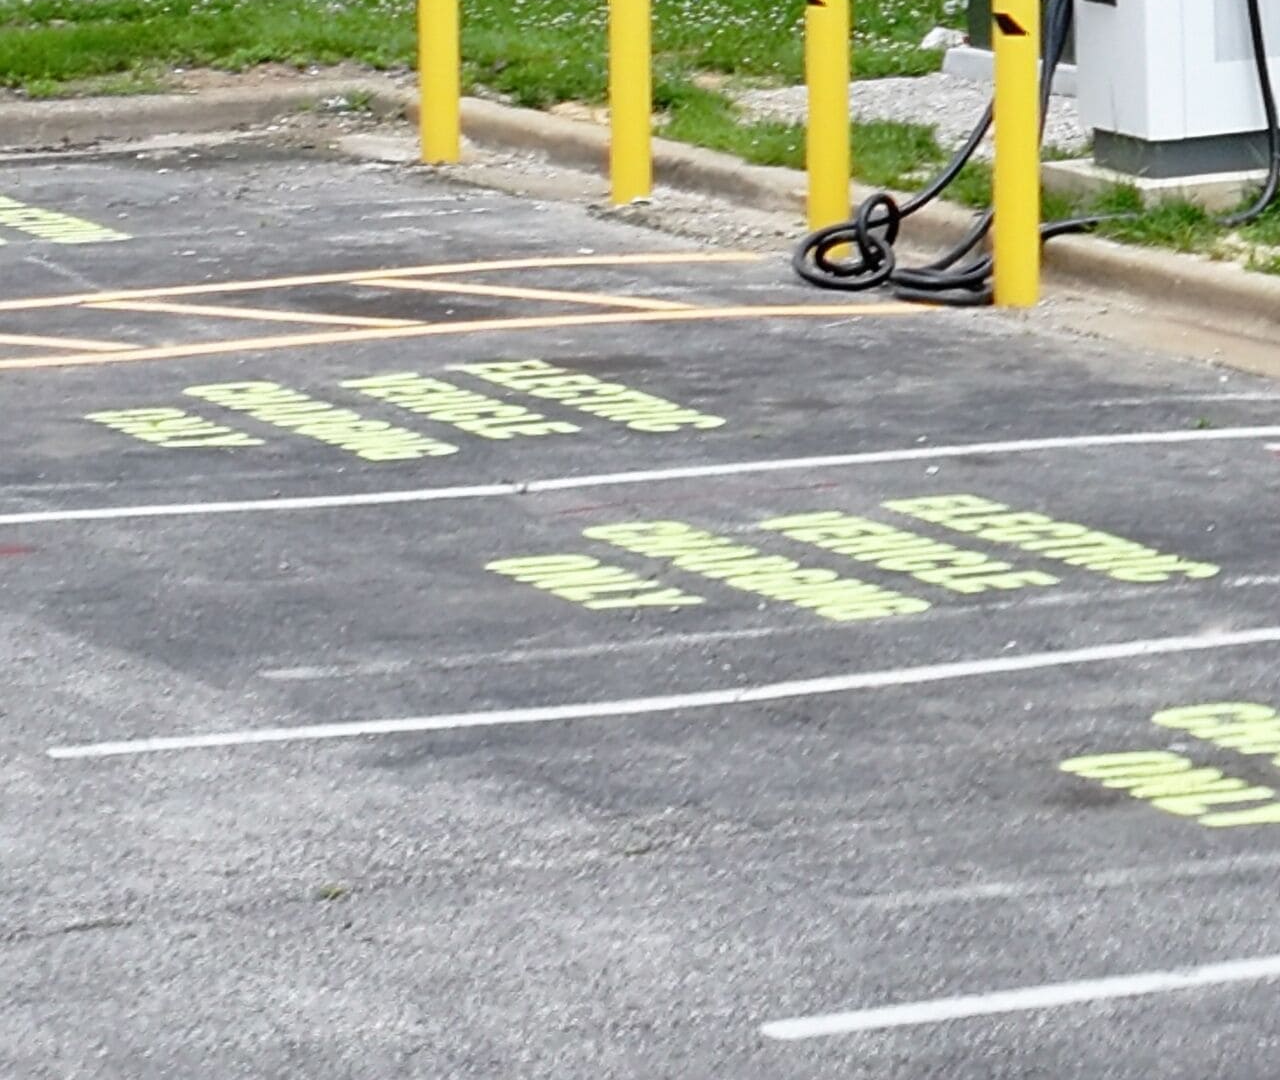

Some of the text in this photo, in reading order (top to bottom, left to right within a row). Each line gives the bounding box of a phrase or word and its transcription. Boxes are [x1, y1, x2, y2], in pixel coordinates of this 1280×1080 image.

[84, 408, 265, 447] ONLY
[181, 381, 460, 461] CHARGING
[338, 372, 583, 439] VEHICLE
[443, 359, 727, 433] ELECTRIC
[582, 521, 932, 622] CHARGING
[758, 511, 1062, 594] VEHICLE
[879, 494, 1221, 583] ELECTRIC
[484, 554, 706, 610] ONLY
